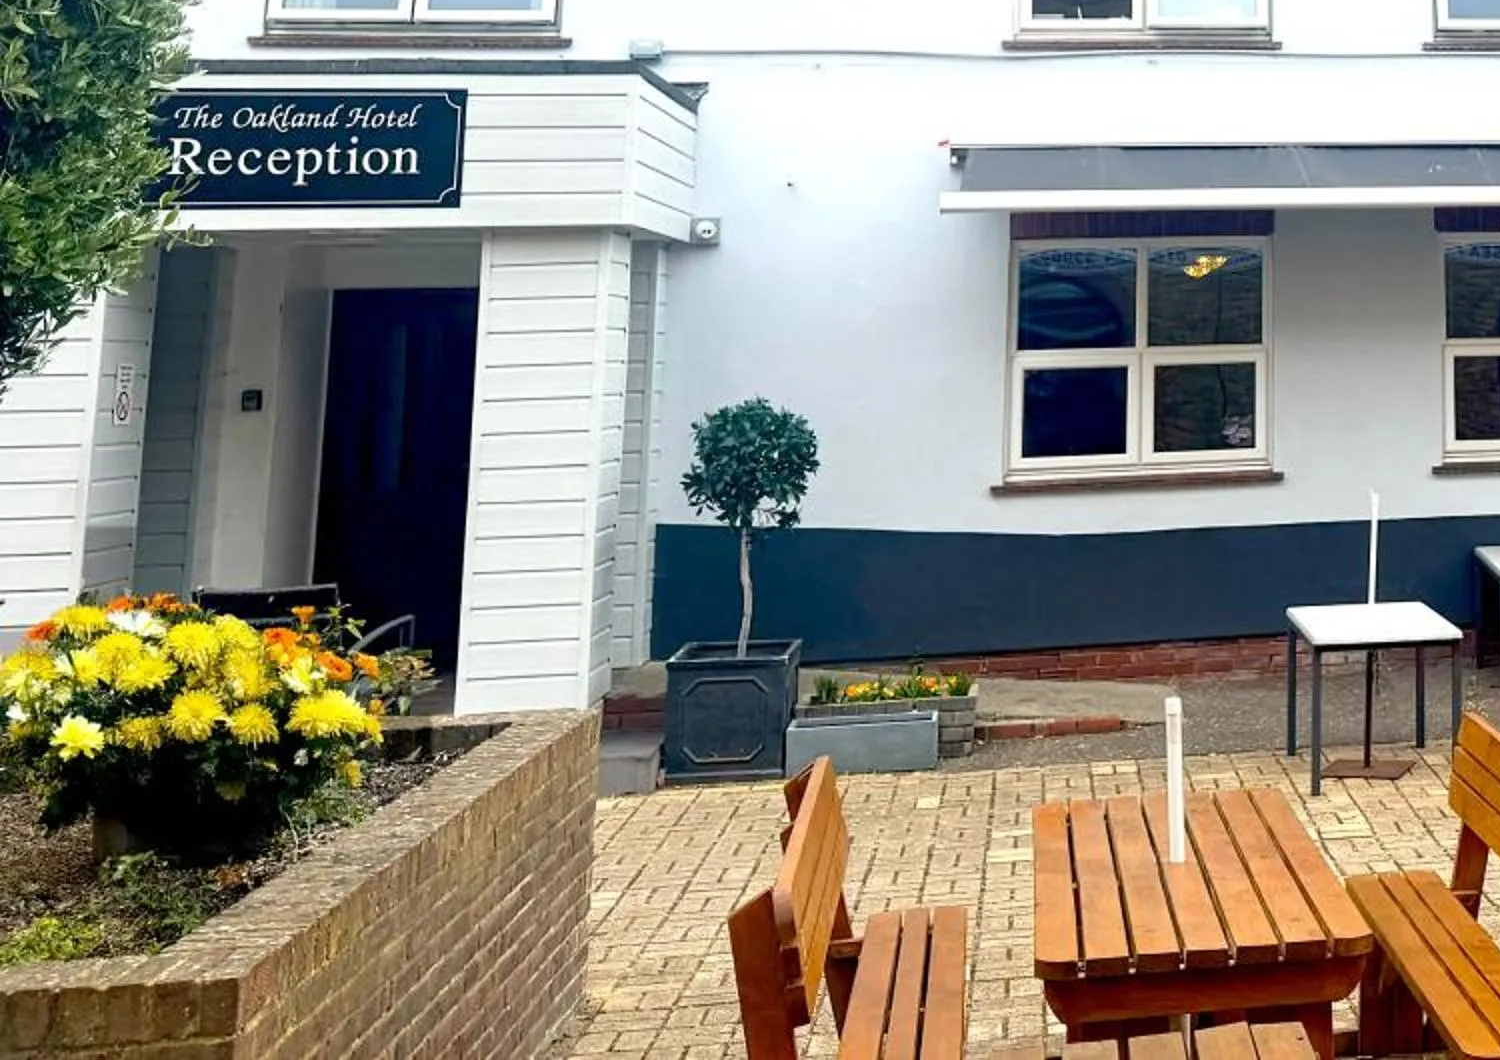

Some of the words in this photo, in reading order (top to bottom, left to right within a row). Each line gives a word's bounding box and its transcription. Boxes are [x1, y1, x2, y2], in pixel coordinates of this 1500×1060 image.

[173, 104, 223, 129] The
[232, 103, 343, 133] Oakland
[348, 103, 423, 130] Hotel
[167, 136, 421, 187] Reception
